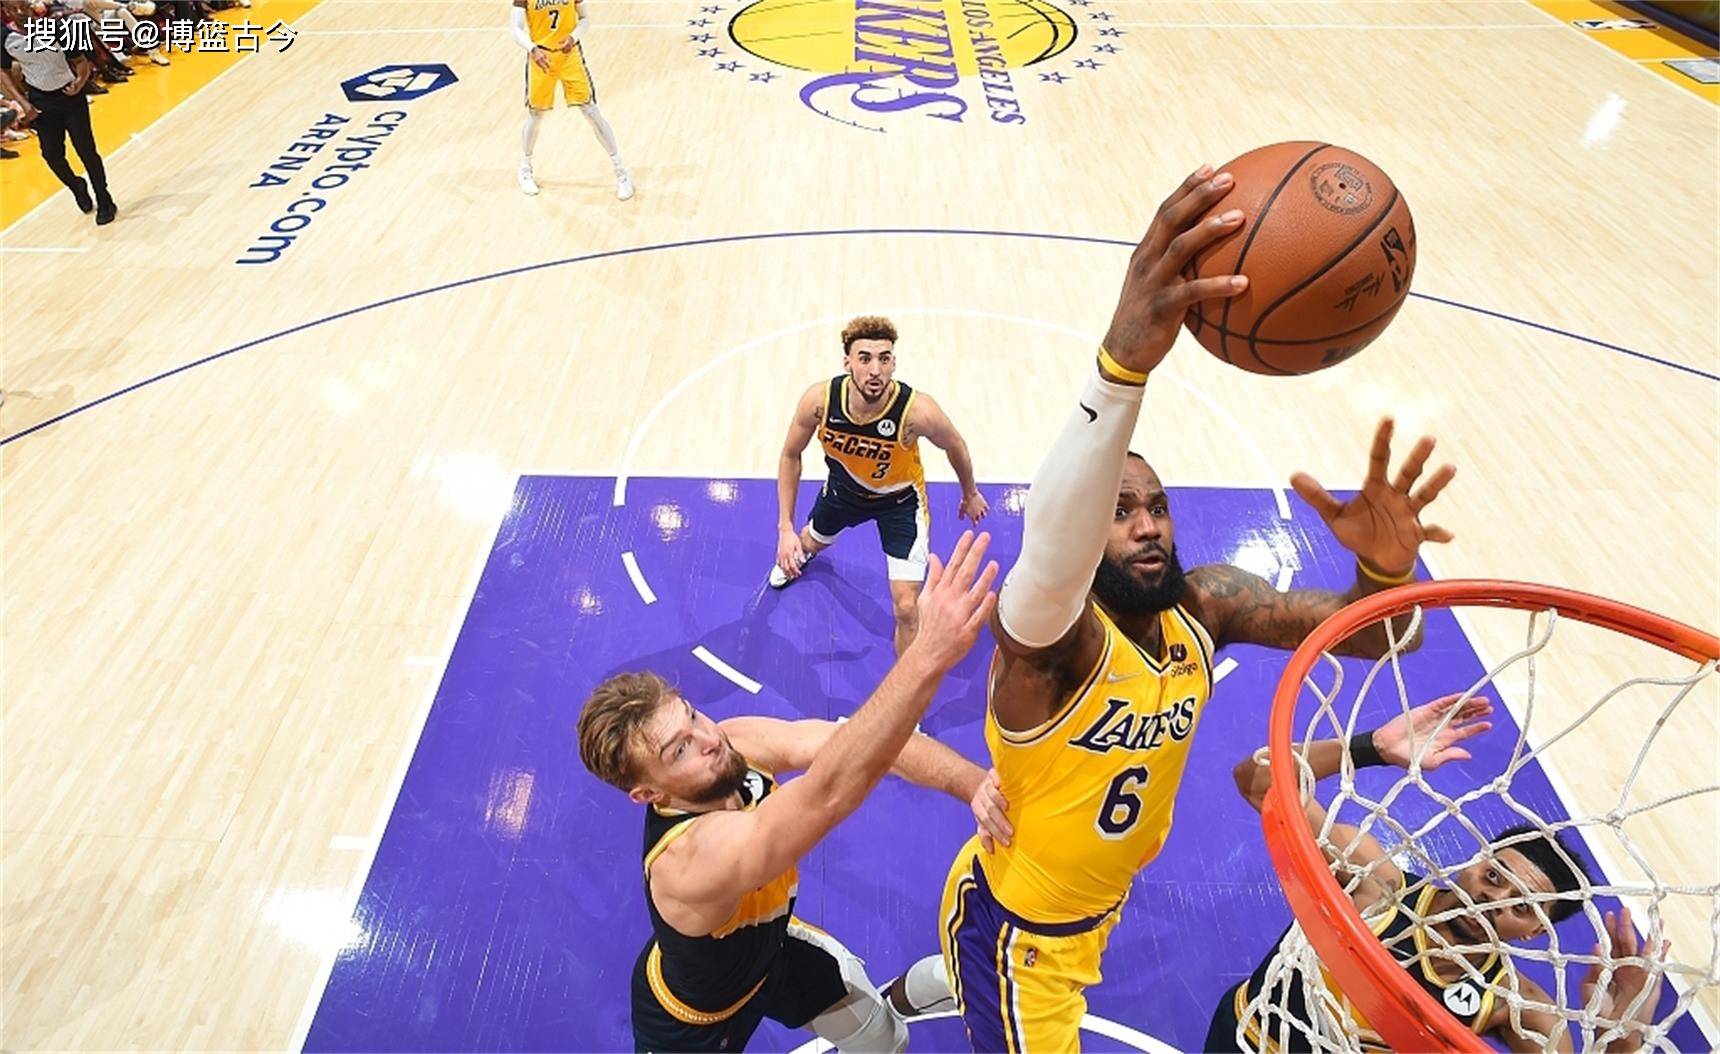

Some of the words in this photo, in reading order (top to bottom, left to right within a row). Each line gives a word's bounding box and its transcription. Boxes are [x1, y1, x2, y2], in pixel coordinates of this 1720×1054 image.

[548, 9, 560, 30] 7
[961, 0, 994, 29] LOS
[968, 29, 1026, 125] ANGELES
[248, 113, 352, 188] ARENA
[235, 110, 408, 264] crypto.com
[823, 431, 895, 461] PACERS
[872, 462, 891, 479] 3
[1096, 765, 1149, 839] 6
